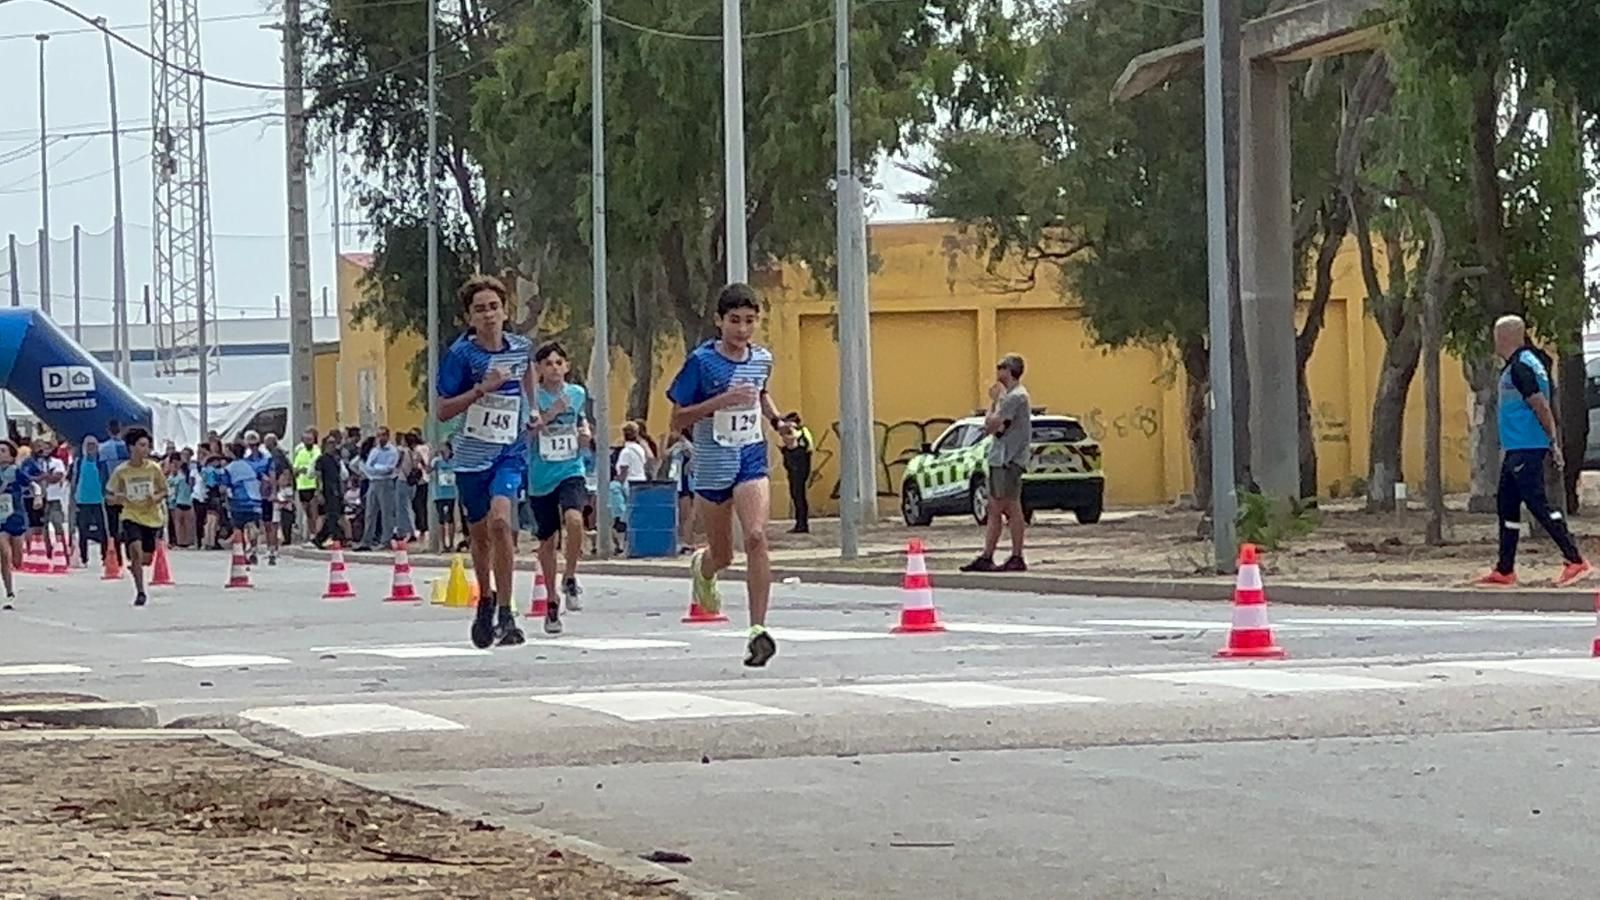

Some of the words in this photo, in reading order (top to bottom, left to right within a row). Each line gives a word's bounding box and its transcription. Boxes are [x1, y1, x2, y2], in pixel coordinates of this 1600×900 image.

[49, 373, 62, 388] D
[45, 399, 97, 409] DEPORTES
[483, 411, 511, 430] 148
[731, 414, 757, 431] 129
[551, 438, 572, 451] 121
